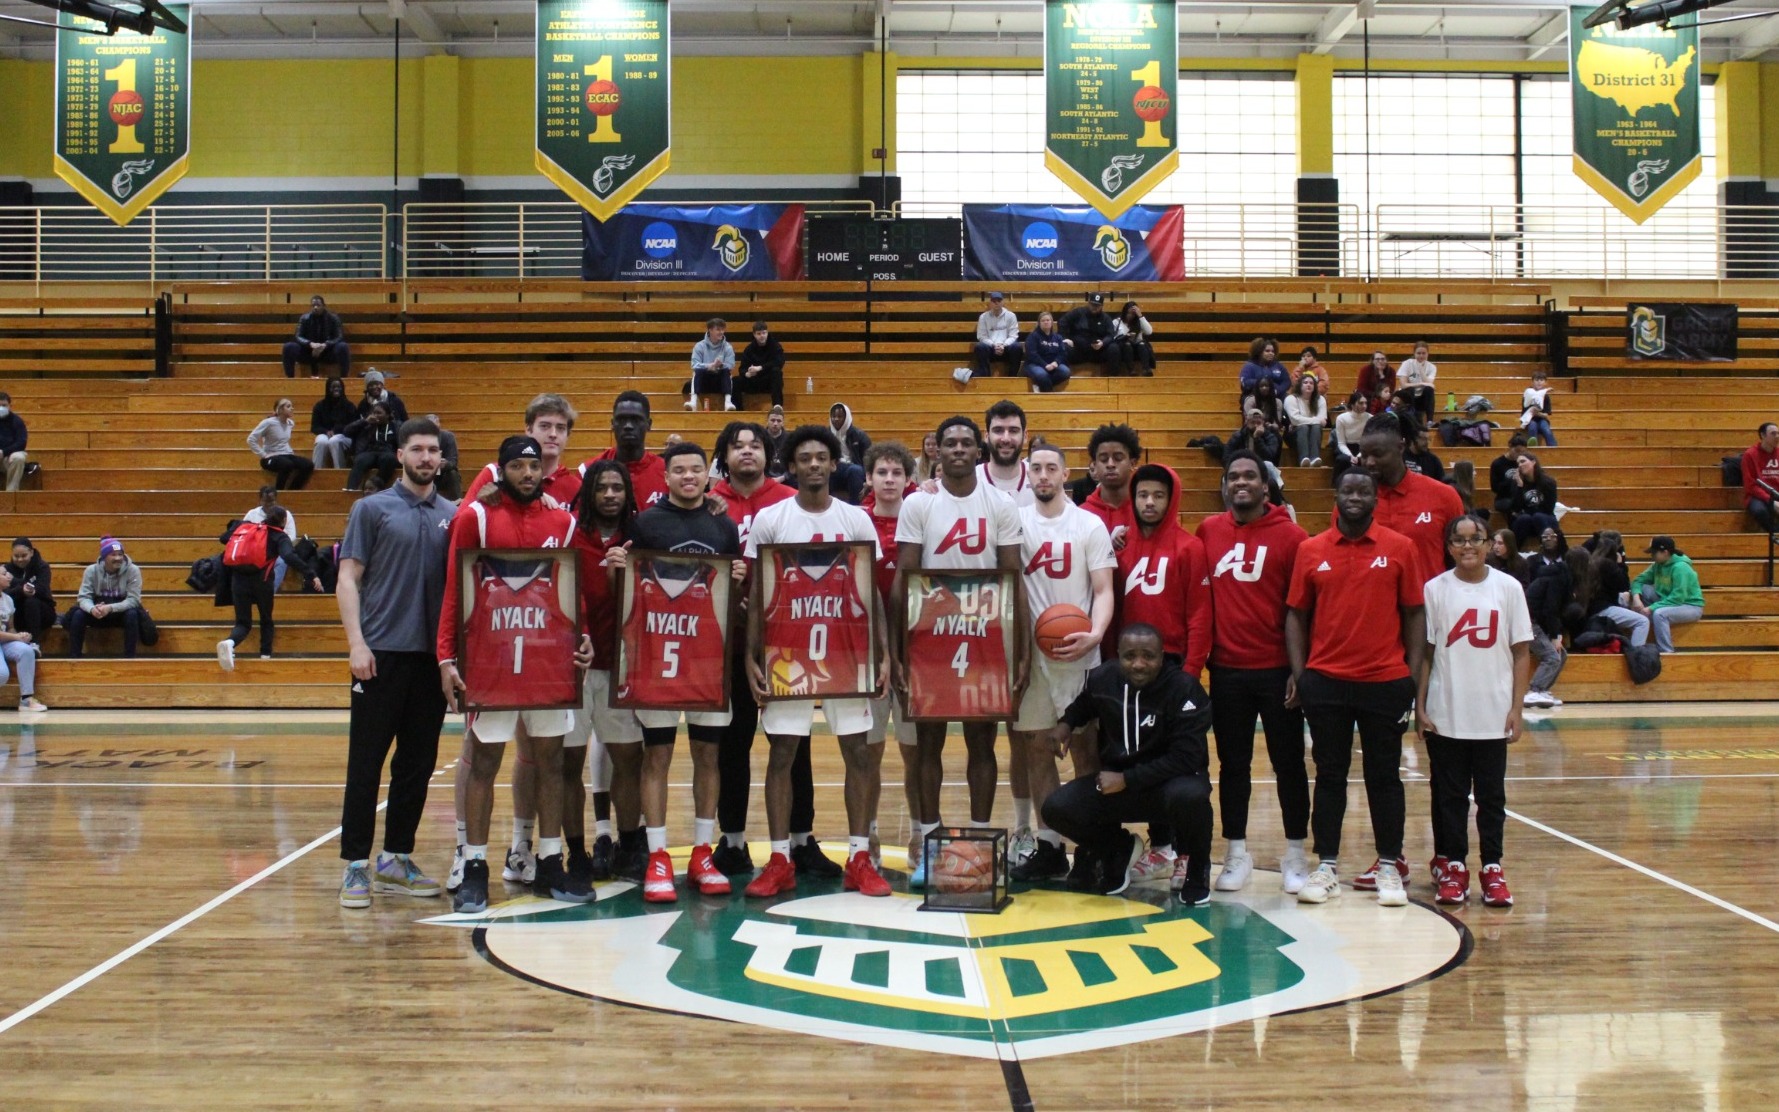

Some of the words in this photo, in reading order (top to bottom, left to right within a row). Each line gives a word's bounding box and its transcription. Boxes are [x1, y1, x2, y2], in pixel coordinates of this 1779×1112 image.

[1593, 73, 1656, 86] District
[1660, 74, 1676, 86] 31
[112, 104, 142, 116] NJAC
[588, 94, 619, 103] ECAC
[644, 239, 676, 249] NCAA
[1026, 238, 1058, 248] NCAA
[636, 260, 673, 269] Division
[818, 252, 849, 261] HOME
[919, 252, 954, 261] GUEST
[1017, 260, 1054, 269] Division
[1415, 512, 1431, 524] AU
[934, 517, 987, 555] AU
[1024, 542, 1071, 579] AU
[1214, 543, 1267, 582] AU
[1370, 556, 1388, 568] AU
[1125, 556, 1169, 595] AU
[492, 606, 546, 631] NYACK
[791, 596, 843, 620] NYACK
[646, 611, 698, 636] NYACK
[933, 614, 989, 637] NYACK
[1446, 608, 1499, 649] AU
[808, 624, 827, 661] 0
[513, 635, 524, 674] 1
[662, 642, 680, 678] 5
[951, 642, 969, 678] 4
[1140, 714, 1156, 727] AU
